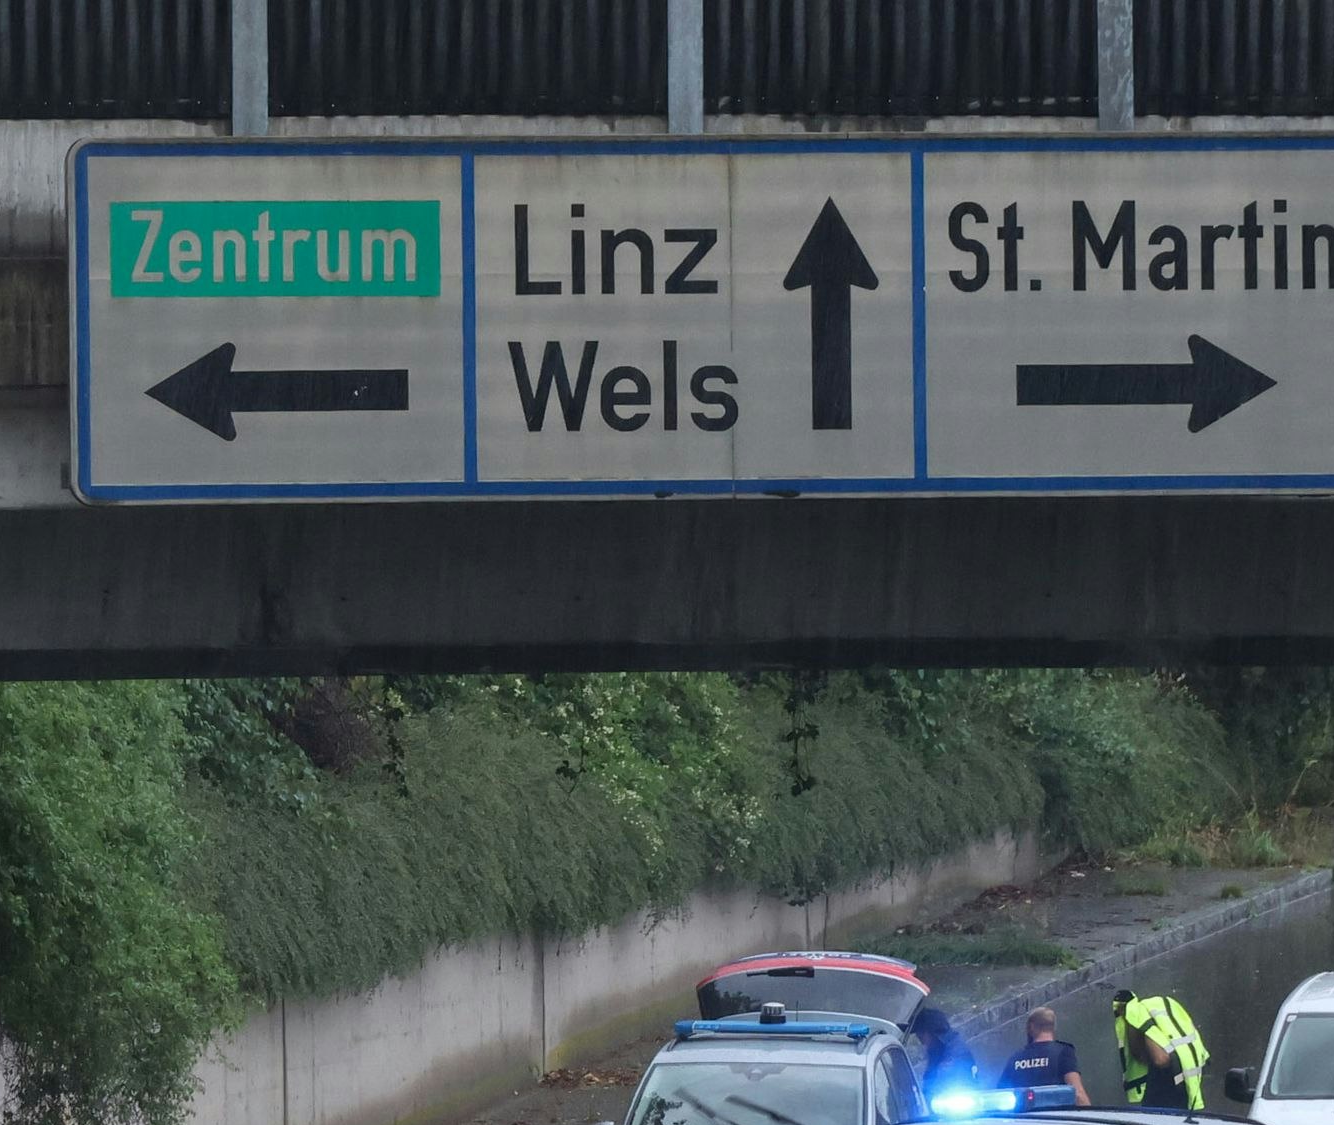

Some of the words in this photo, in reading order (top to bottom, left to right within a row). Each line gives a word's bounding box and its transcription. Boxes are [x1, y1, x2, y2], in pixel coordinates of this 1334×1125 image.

[131, 209, 416, 284] Zentrum
[514, 203, 718, 295] Linz
[948, 201, 1042, 292] St.
[507, 339, 739, 432] Wels
[1014, 1058, 1049, 1070] POLIZEI
